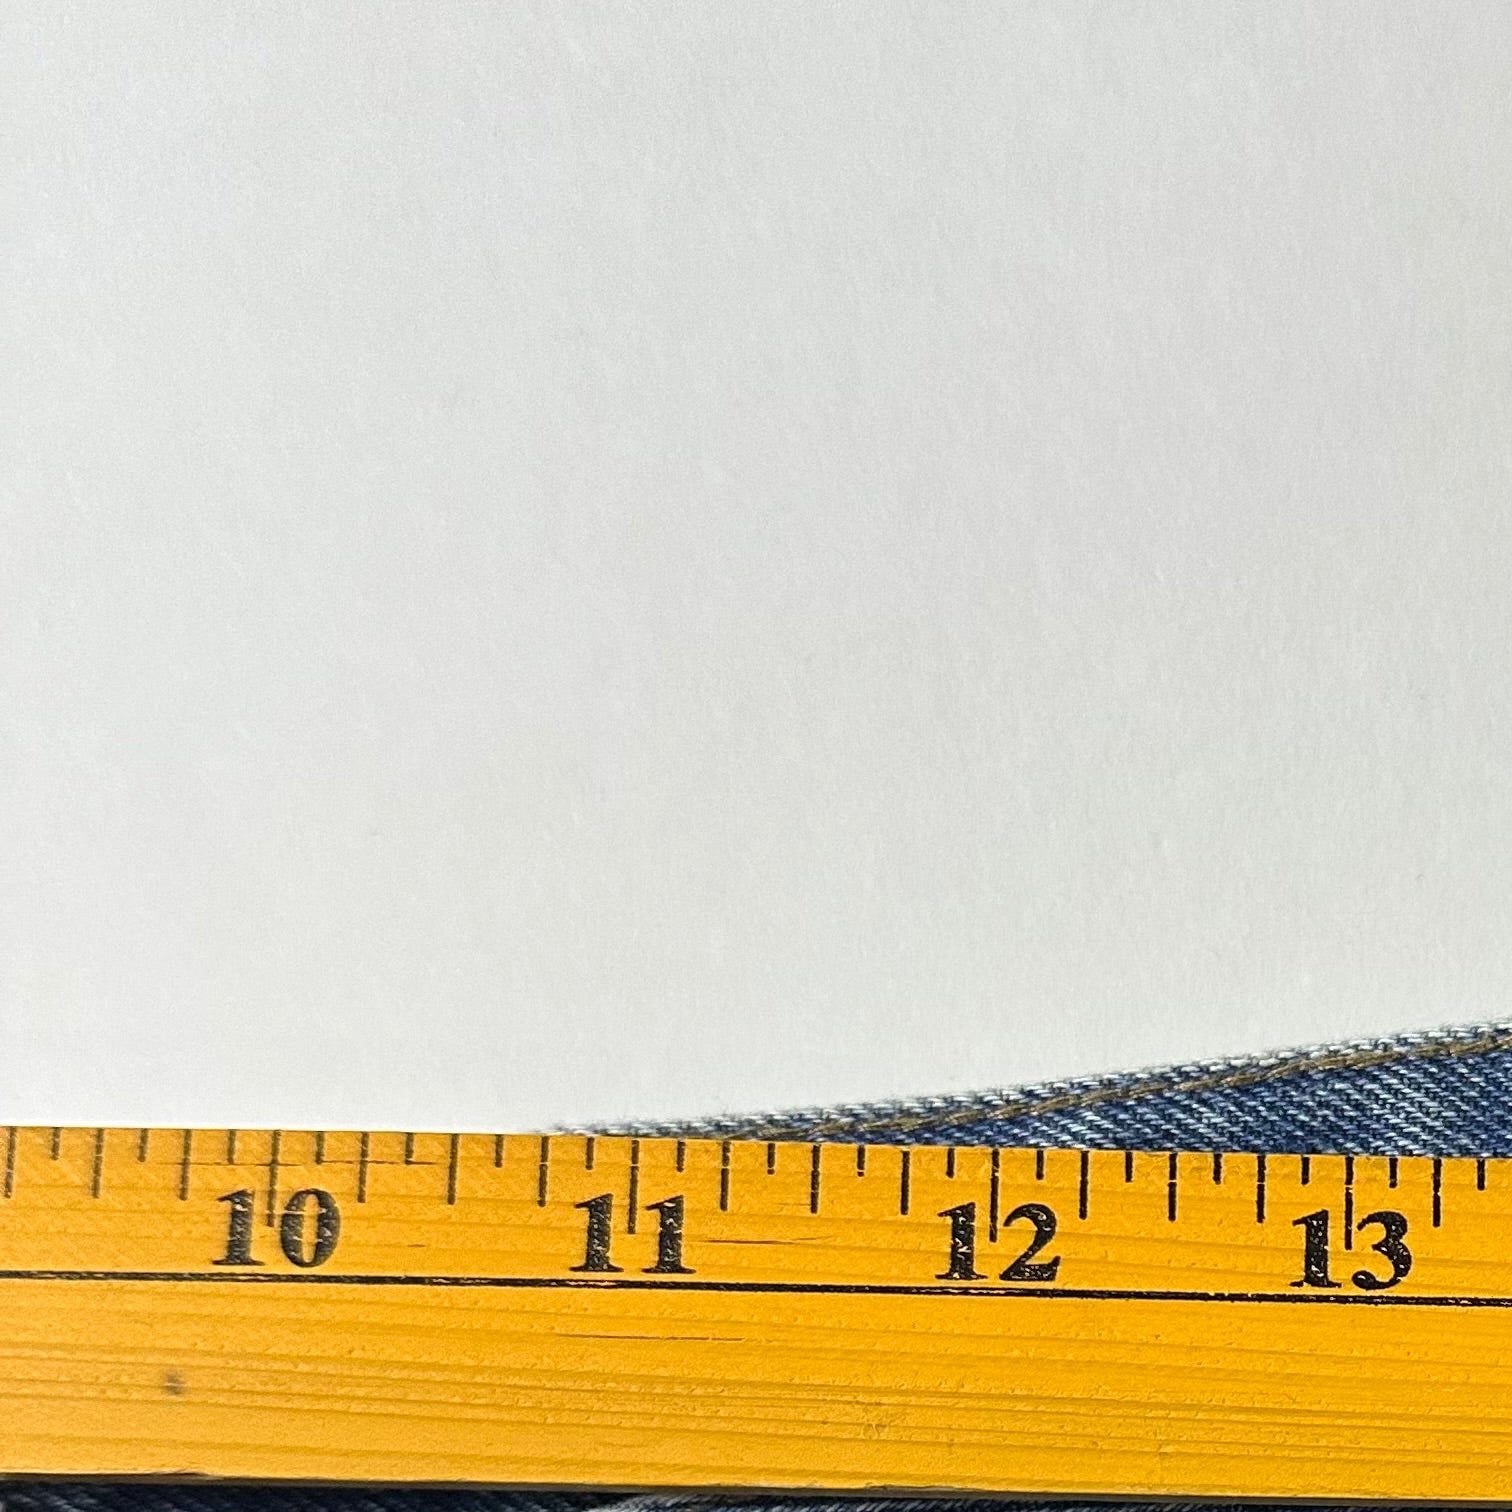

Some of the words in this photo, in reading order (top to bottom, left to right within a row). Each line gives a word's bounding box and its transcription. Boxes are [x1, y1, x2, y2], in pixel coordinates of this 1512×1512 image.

[212, 1189, 340, 1268] 10
[569, 1193, 695, 1275] 11
[935, 1201, 1061, 1282] 12
[1289, 1209, 1412, 1292] 13
